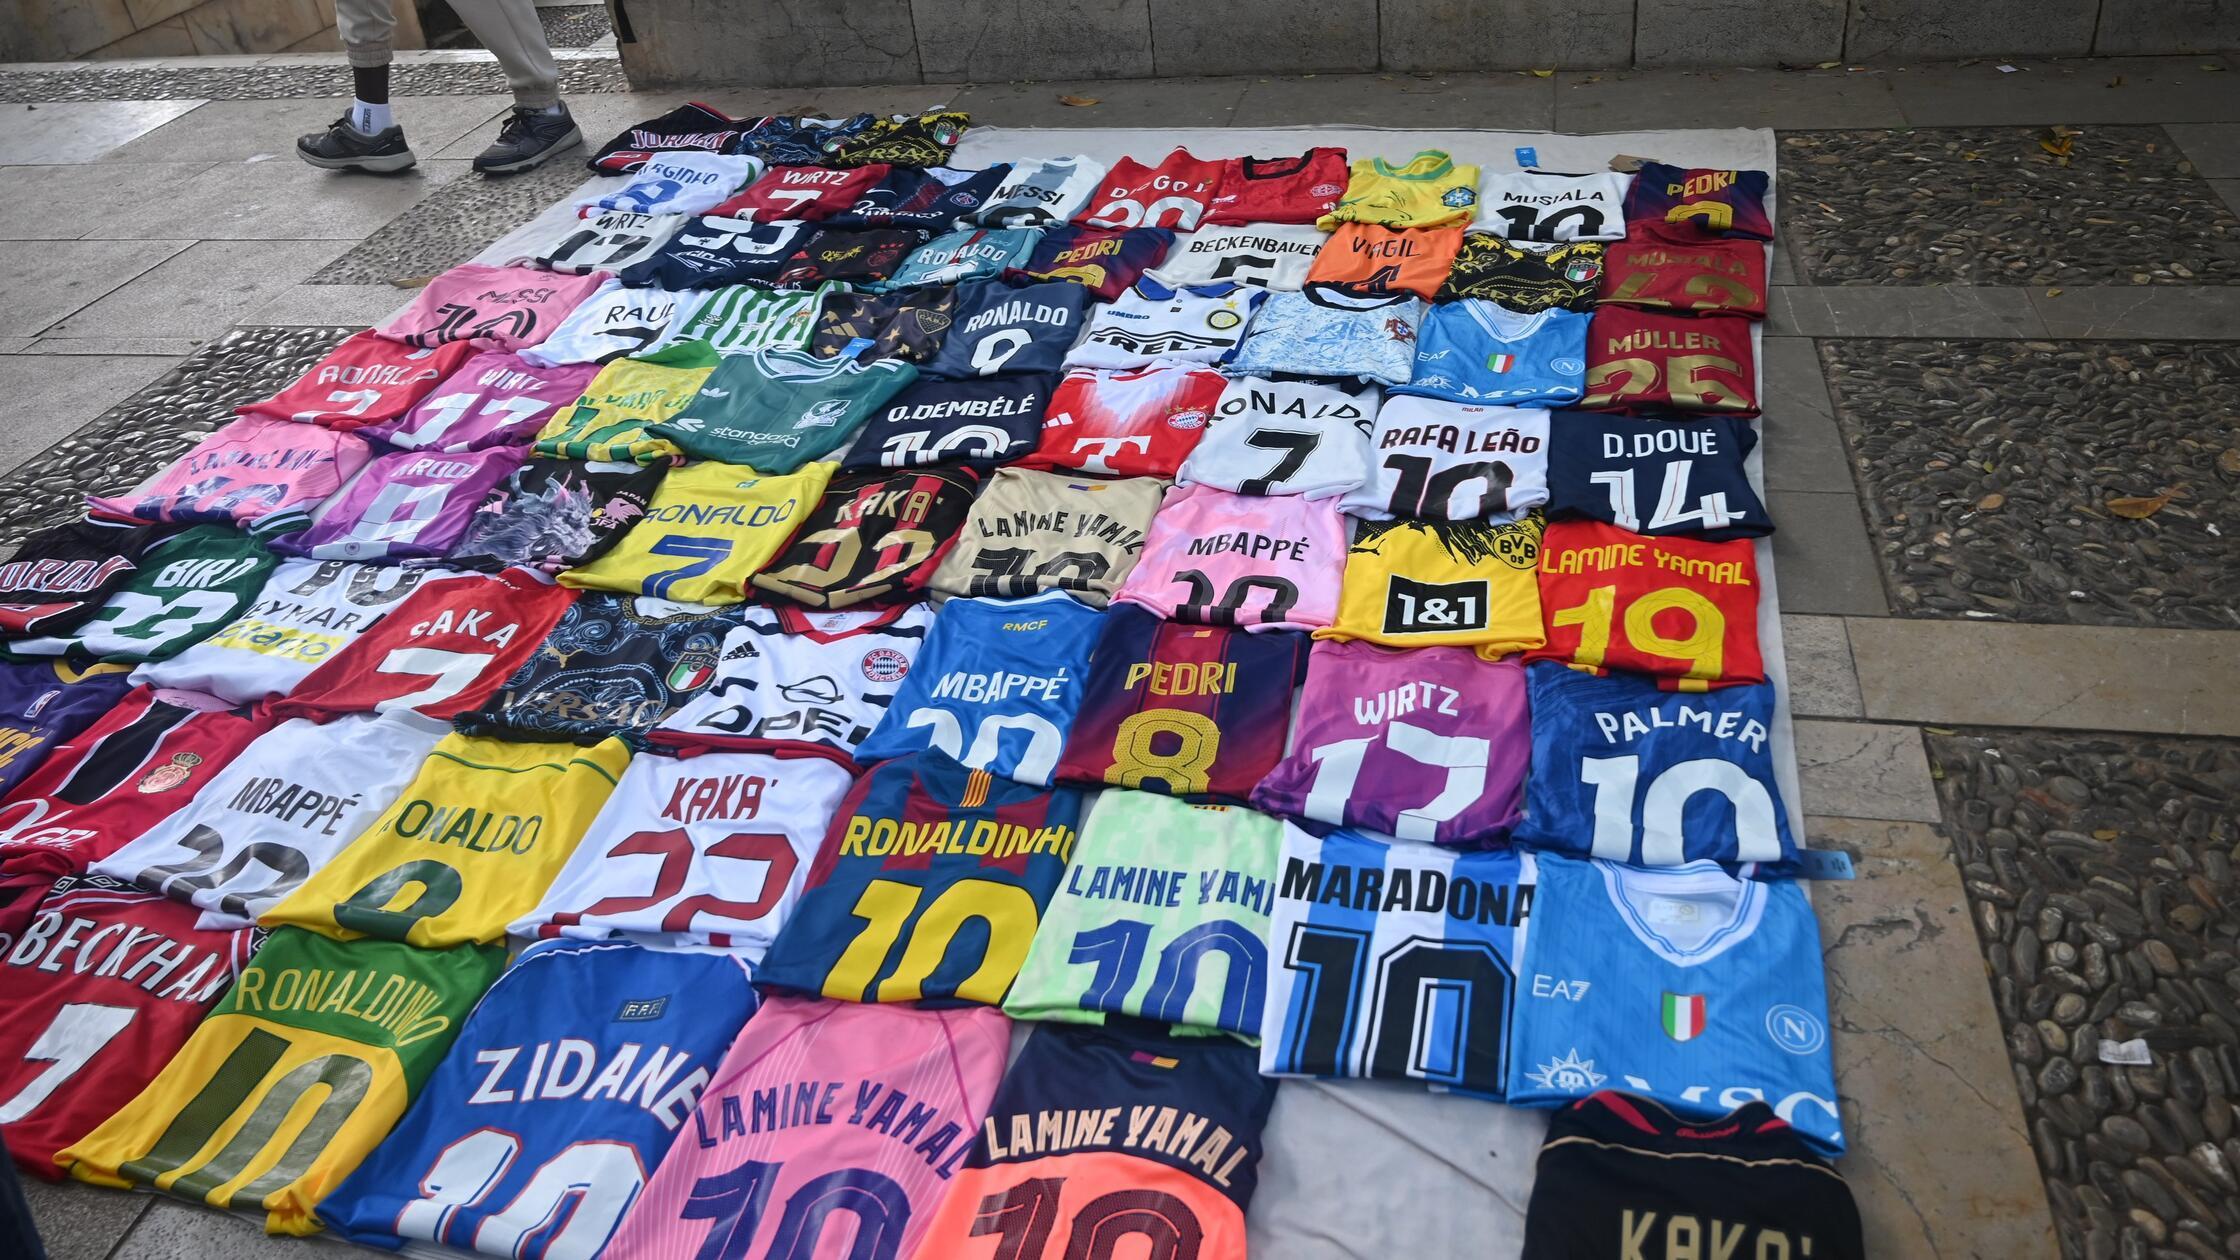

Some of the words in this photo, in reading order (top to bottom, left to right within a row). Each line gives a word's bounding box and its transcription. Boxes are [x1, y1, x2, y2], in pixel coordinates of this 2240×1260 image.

[782, 170, 850, 186] WIRTZ
[994, 183, 1065, 206] MESSI
[1503, 188, 1605, 206] MUSIALA
[1667, 170, 1738, 198] PEDRI
[767, 189, 822, 212] 7
[1496, 204, 1604, 241] 10
[917, 243, 1007, 265] RONALDO
[1053, 239, 1124, 264] PEDRI
[1352, 236, 1421, 259] VIRGIL
[963, 301, 1069, 335] RONALDO
[1608, 329, 1720, 355] MÜLLER
[888, 394, 1035, 422] O.DEMBÉLÉ
[712, 426, 801, 449] standard
[880, 425, 1010, 468] 10
[1380, 424, 1460, 454] RAFA
[1464, 428, 1541, 455] LEÃO
[1603, 427, 1717, 459] D.DOUÉ
[1237, 428, 1324, 496] 7
[615, 489, 648, 507] JAPAN
[1383, 453, 1514, 521] 10
[1590, 459, 1746, 531] 14
[589, 518, 620, 530] JFA
[978, 510, 1069, 539] LAMINE
[641, 534, 737, 600] 7
[1188, 531, 1310, 562] MBAPPÉ
[1499, 535, 1536, 558] BVB
[1541, 543, 1644, 575] LAMINE
[1652, 547, 1751, 586] YAMAL
[152, 557, 259, 589] BIRD
[969, 547, 1111, 597] 10
[1002, 619, 1049, 633] RMCF
[1397, 593, 1476, 626] 1&1
[721, 651, 760, 662] adidas
[1552, 584, 1726, 690] 19
[376, 647, 496, 717] 7
[930, 667, 1069, 704] MBAPPÉ
[1124, 662, 1238, 696] PEDRI
[1353, 680, 1461, 725] WIRTZ
[1103, 708, 1222, 794] 8
[1594, 705, 1768, 754] PALMER
[1303, 720, 1490, 842] 17
[228, 776, 368, 836] MBAPPÉ
[377, 798, 543, 856] ONALDO
[1581, 755, 1782, 864] 10
[540, 827, 799, 940] 22
[1067, 863, 1188, 908] LAMINE
[1279, 857, 1535, 927] MARADONA
[820, 878, 1039, 1006] 10
[1067, 919, 1268, 1039] 10
[1532, 974, 1591, 1002] EA7
[1284, 921, 1517, 1094] 10
[468, 1038, 712, 1132] ZIDANE
[116, 1026, 373, 1204] 10
[696, 1080, 844, 1149] LAMINE
[847, 1078, 978, 1181] YAMAL
[984, 1106, 1121, 1162] LAMINE
[1123, 1104, 1249, 1189] YAMAL
[680, 1159, 913, 1260] 10
[969, 1177, 1205, 1260] 10
